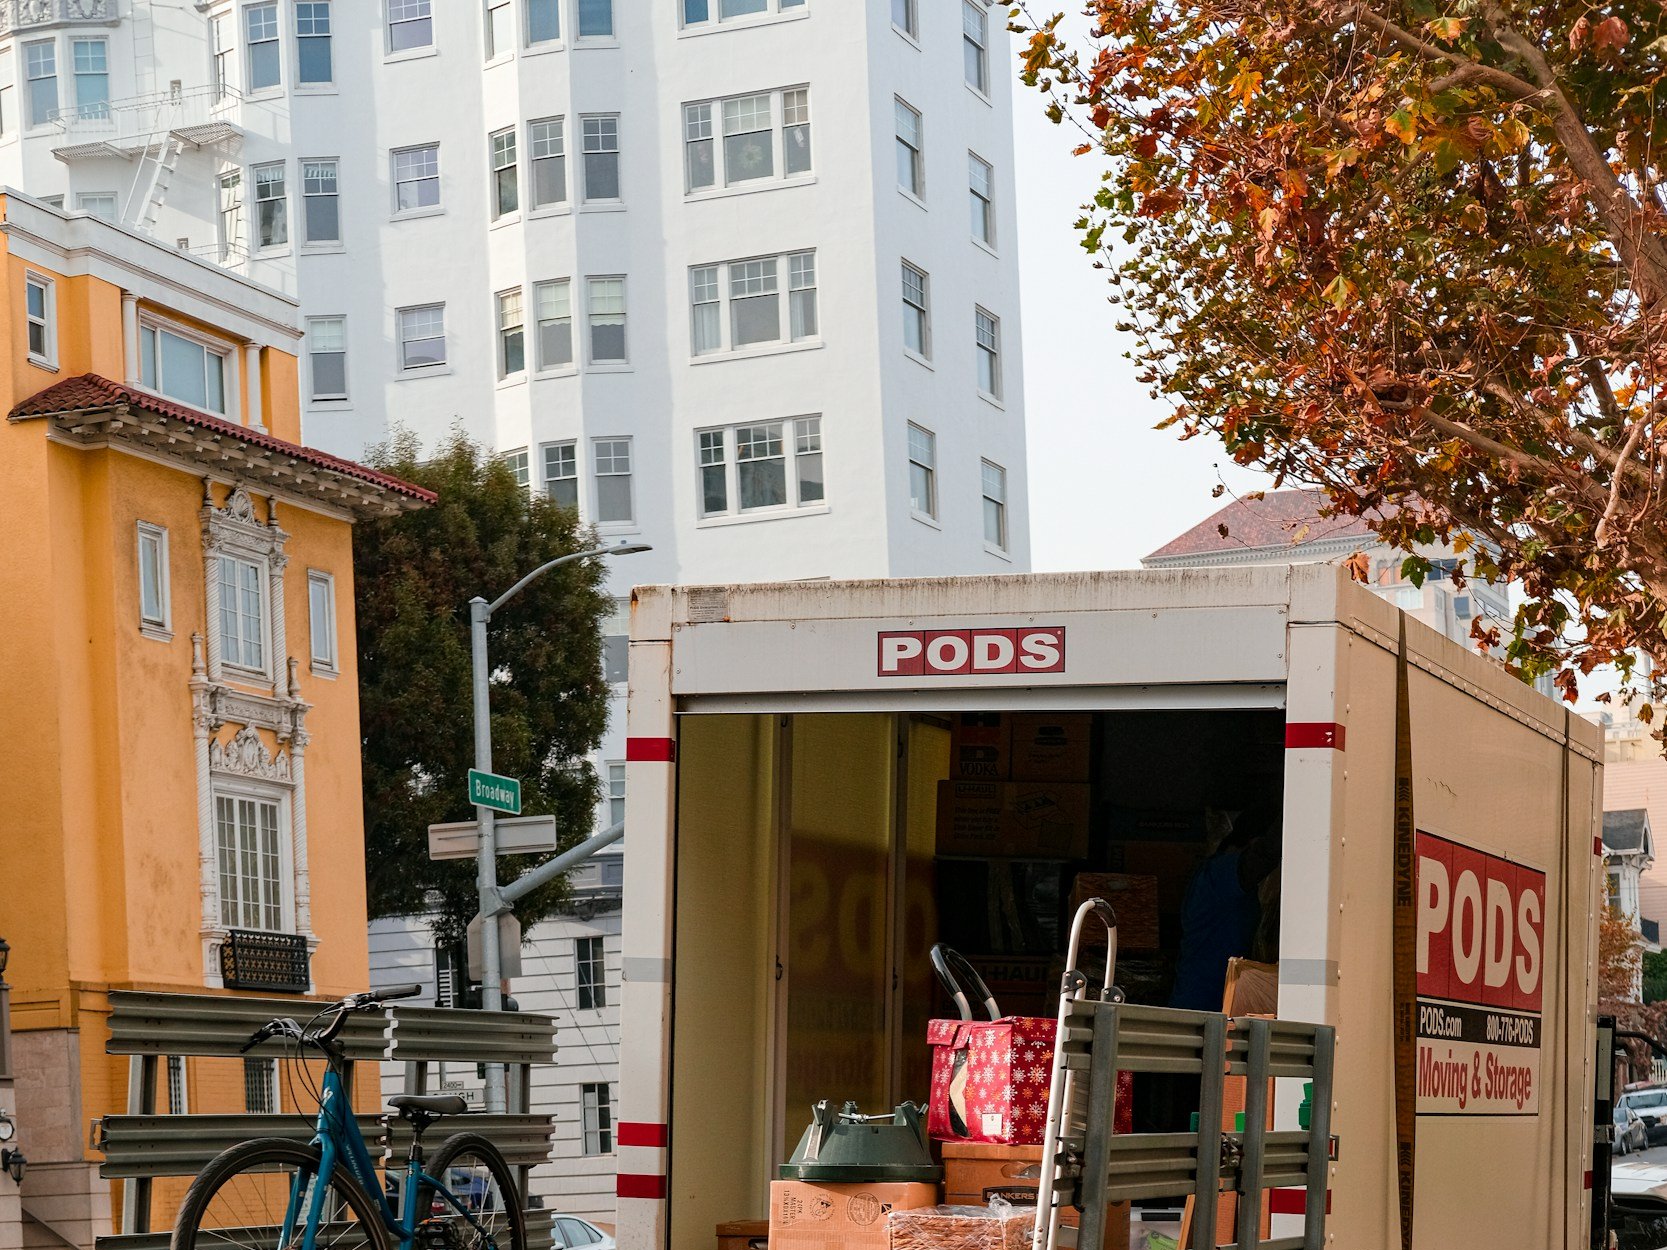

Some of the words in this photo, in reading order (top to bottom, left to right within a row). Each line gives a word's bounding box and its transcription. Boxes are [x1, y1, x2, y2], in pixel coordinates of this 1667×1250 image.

[882, 633, 1060, 671] PODS
[960, 763, 998, 776] VODKA
[475, 779, 514, 808] Broadway
[1397, 806, 1411, 906] KINEDYNE
[1416, 855, 1541, 995] PODS
[1420, 1006, 1462, 1037] PODS.com
[1487, 1014, 1534, 1044] 800-776-PODS
[1418, 1046, 1468, 1110] Moving
[1471, 1050, 1482, 1098] &
[1485, 1053, 1532, 1110] Storage
[987, 1192, 1035, 1200] BNKERS
